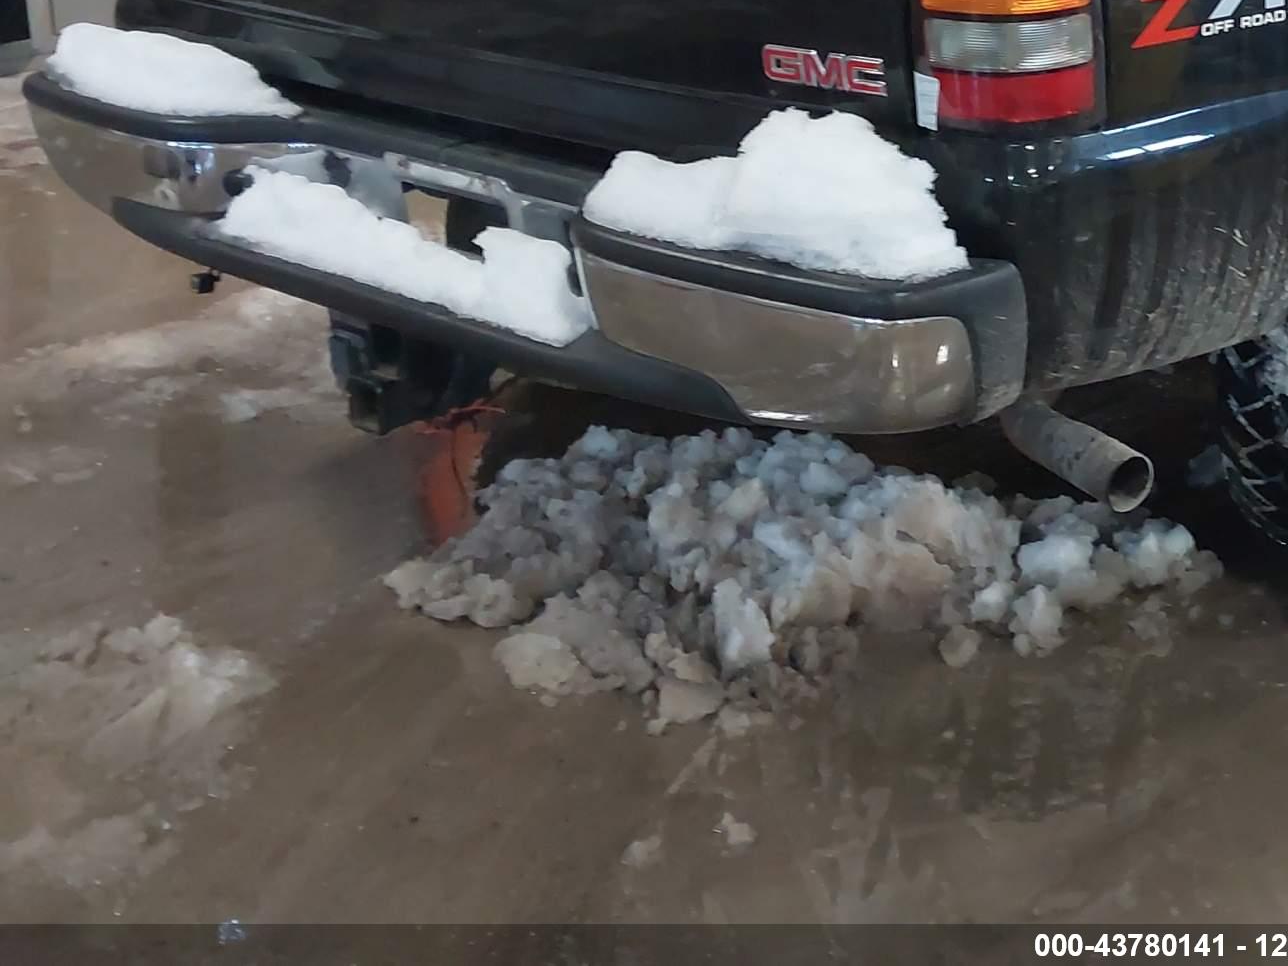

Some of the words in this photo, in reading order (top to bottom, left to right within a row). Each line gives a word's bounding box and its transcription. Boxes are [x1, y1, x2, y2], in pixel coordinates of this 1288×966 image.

[1200, 19, 1235, 37] OFF
[1239, 9, 1287, 29] ROAD
[762, 44, 888, 97] GMC
